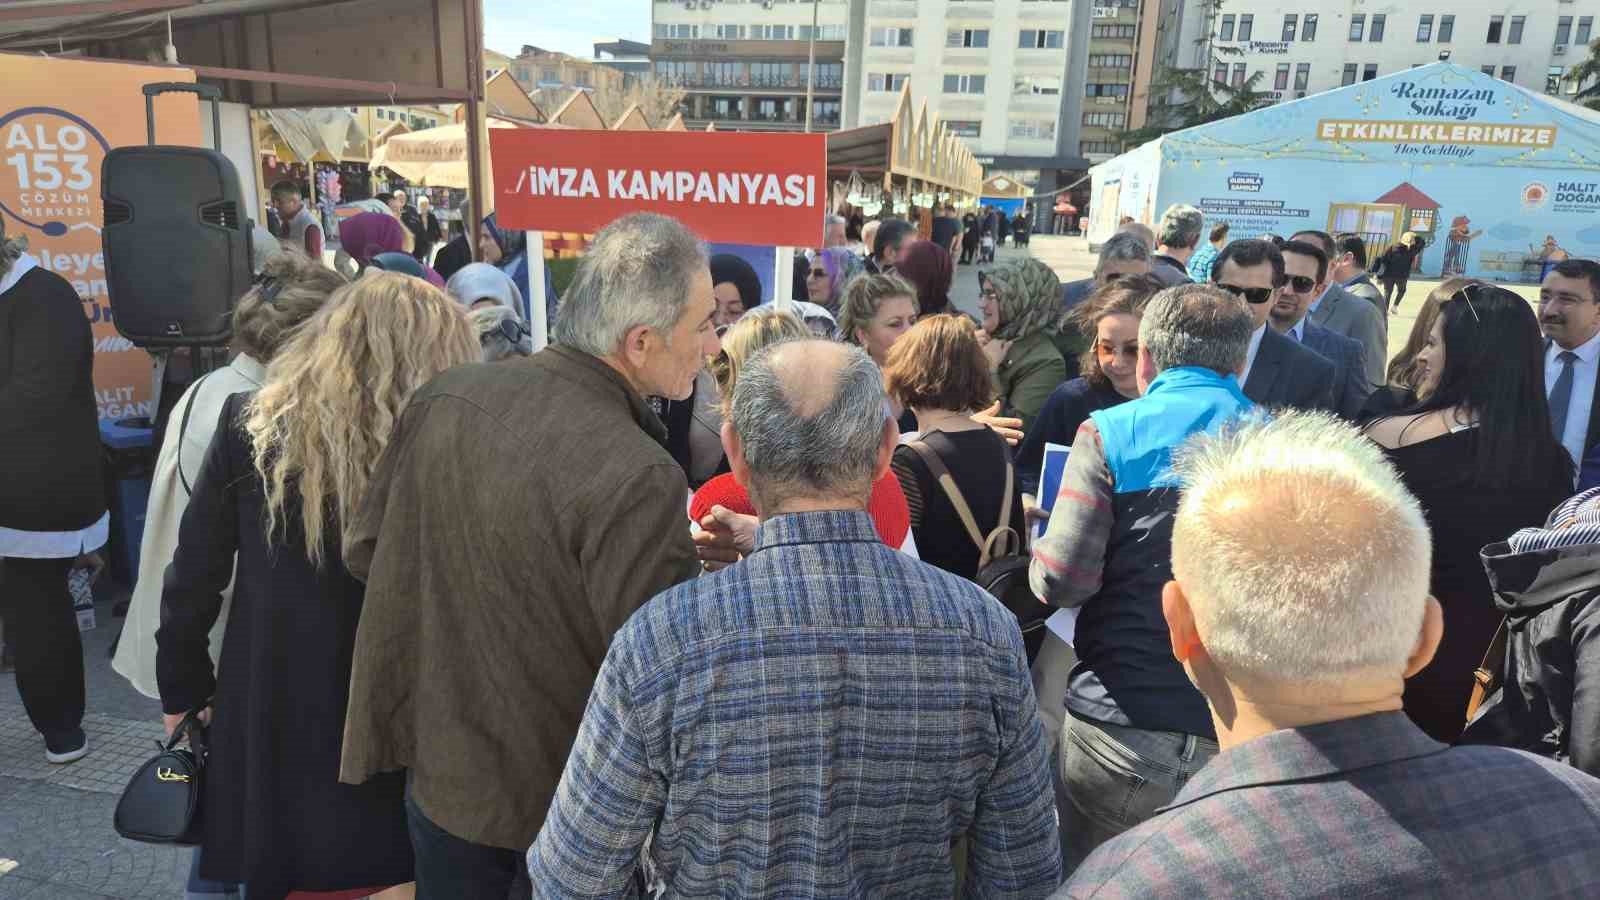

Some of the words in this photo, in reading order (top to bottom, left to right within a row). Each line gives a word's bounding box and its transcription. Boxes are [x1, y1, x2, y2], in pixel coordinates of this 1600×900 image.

[1391, 82, 1496, 105] Ramazan
[6, 124, 87, 151] ALO
[7, 153, 93, 190] 153
[20, 192, 89, 205] ÇÖZÜM
[607, 168, 815, 207] KAMPANYASI
